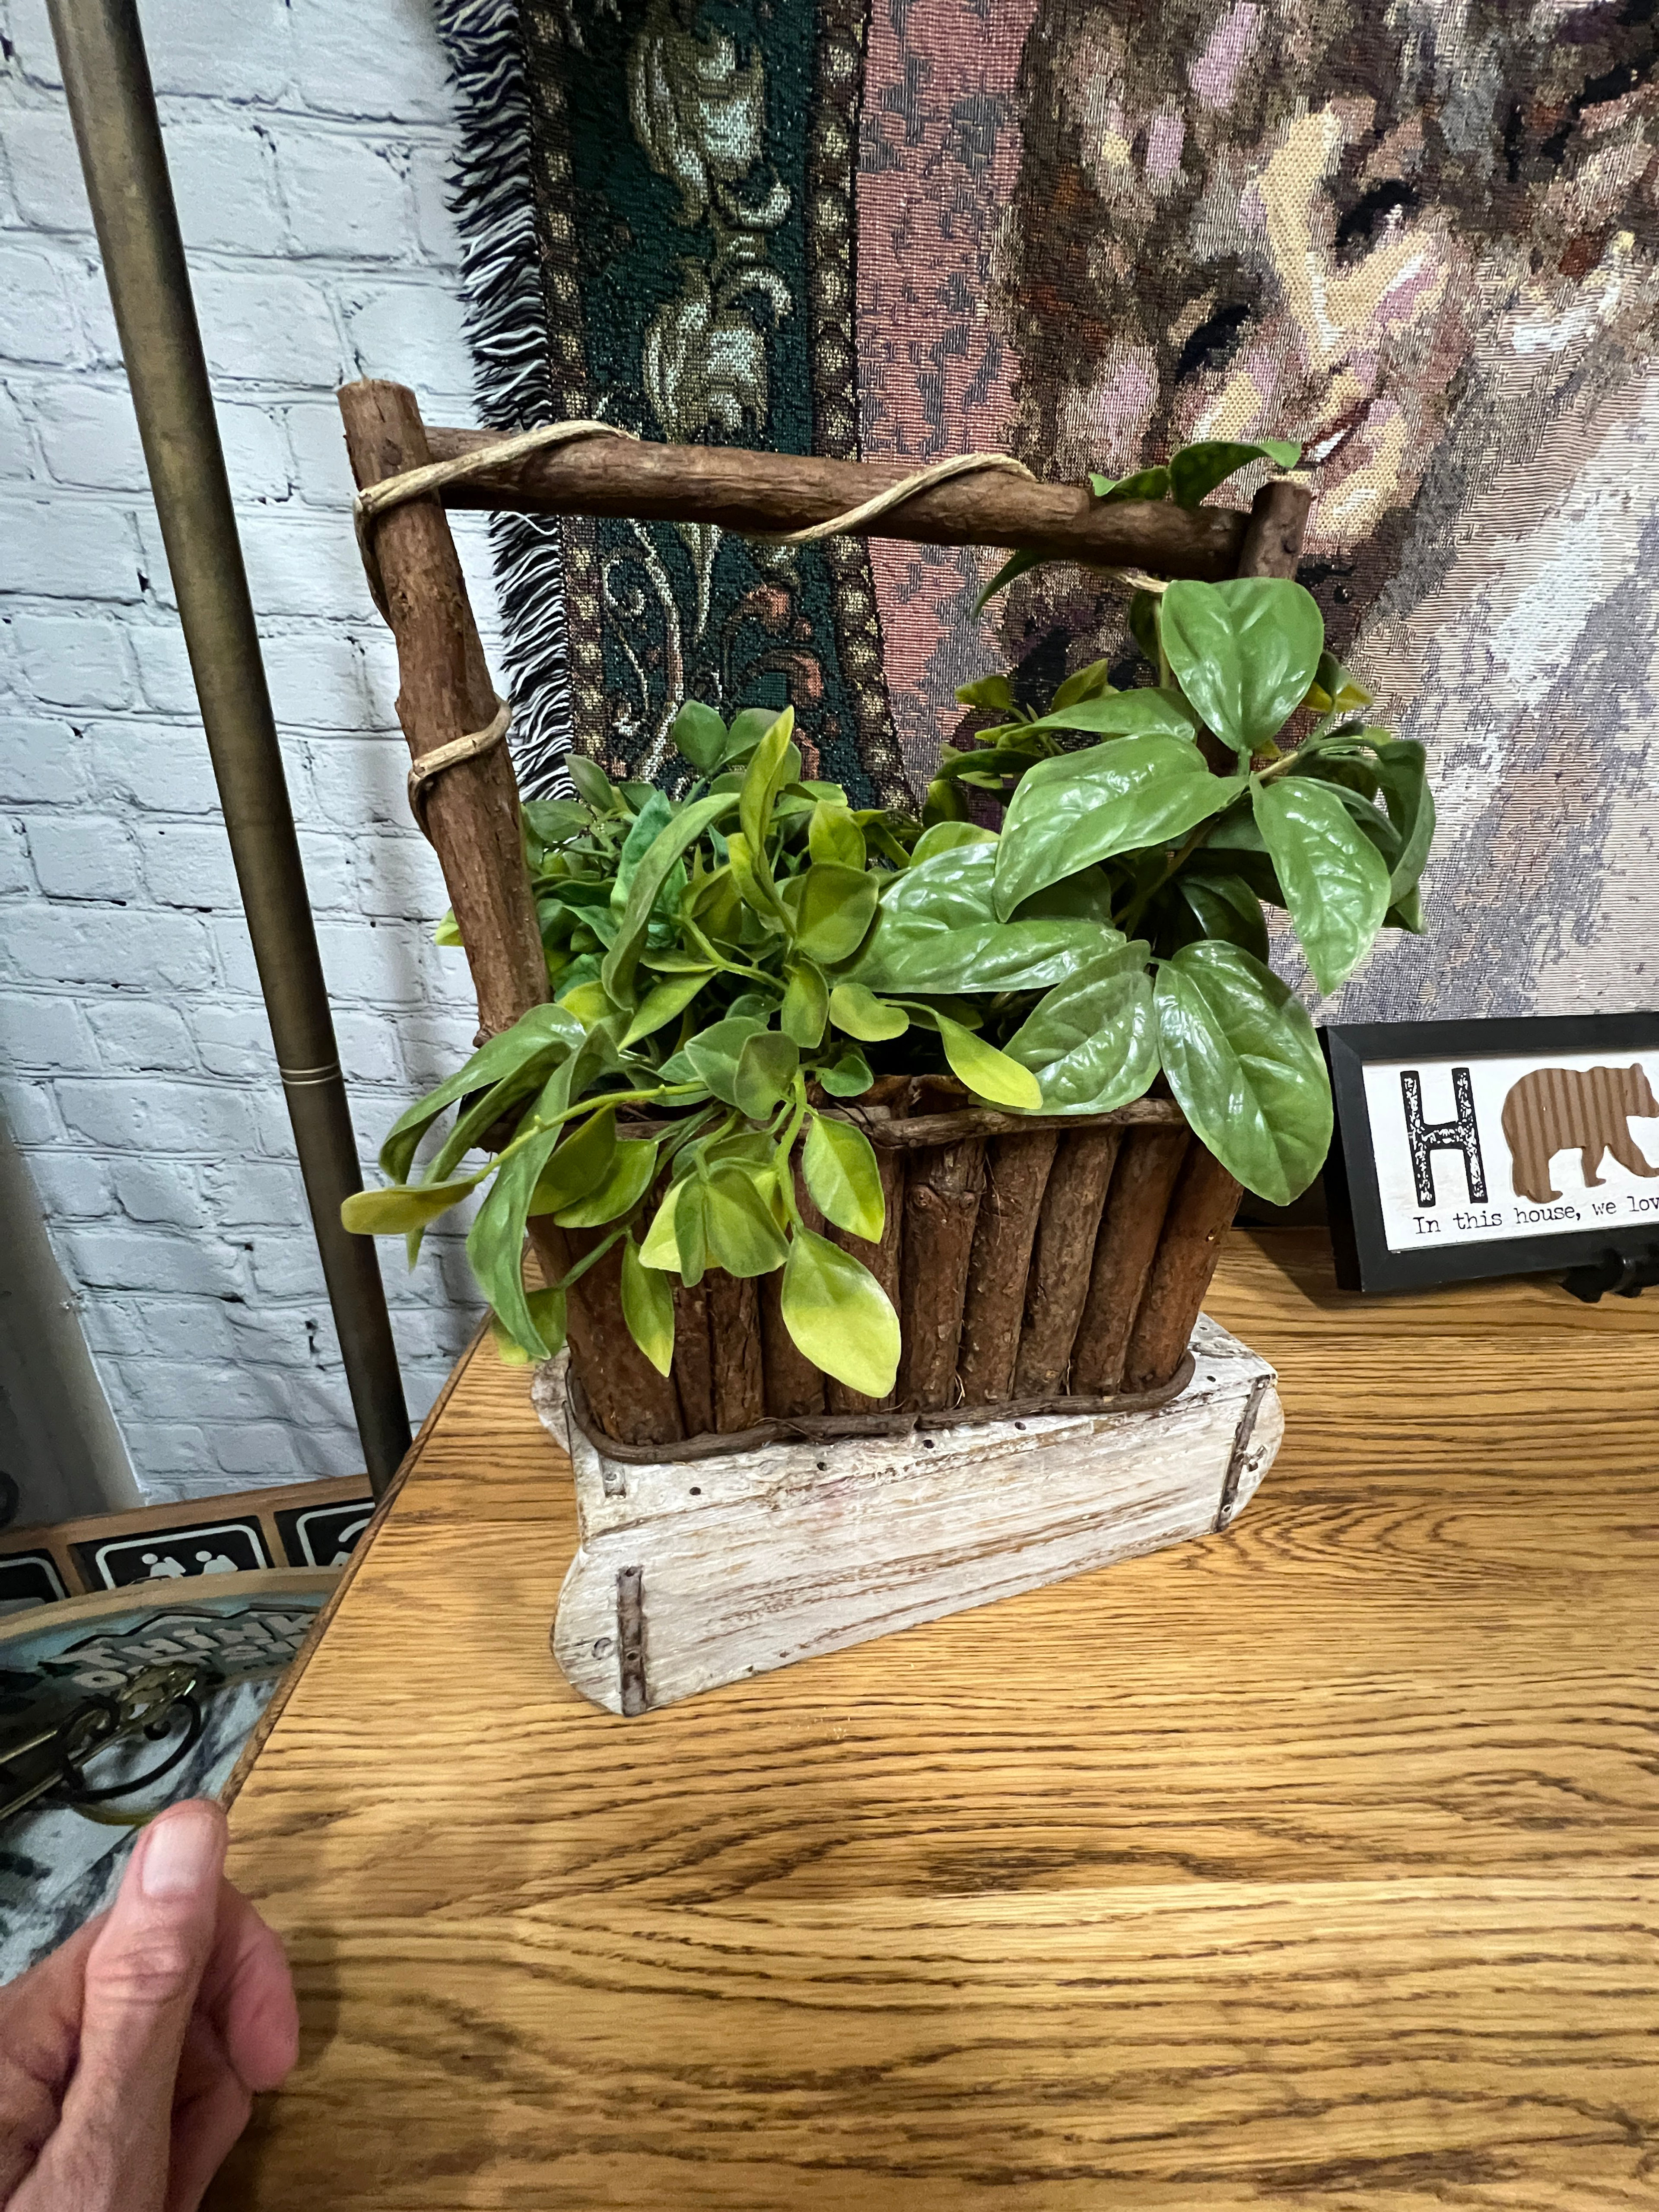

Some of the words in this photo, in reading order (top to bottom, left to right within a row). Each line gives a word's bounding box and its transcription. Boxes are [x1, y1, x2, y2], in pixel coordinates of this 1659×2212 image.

[1400, 1067, 1488, 1208] H
[1413, 1216, 1441, 1234] In
[1453, 1210, 1503, 1230] this
[1513, 1205, 1581, 1224] house,
[1592, 1201, 1617, 1216] we
